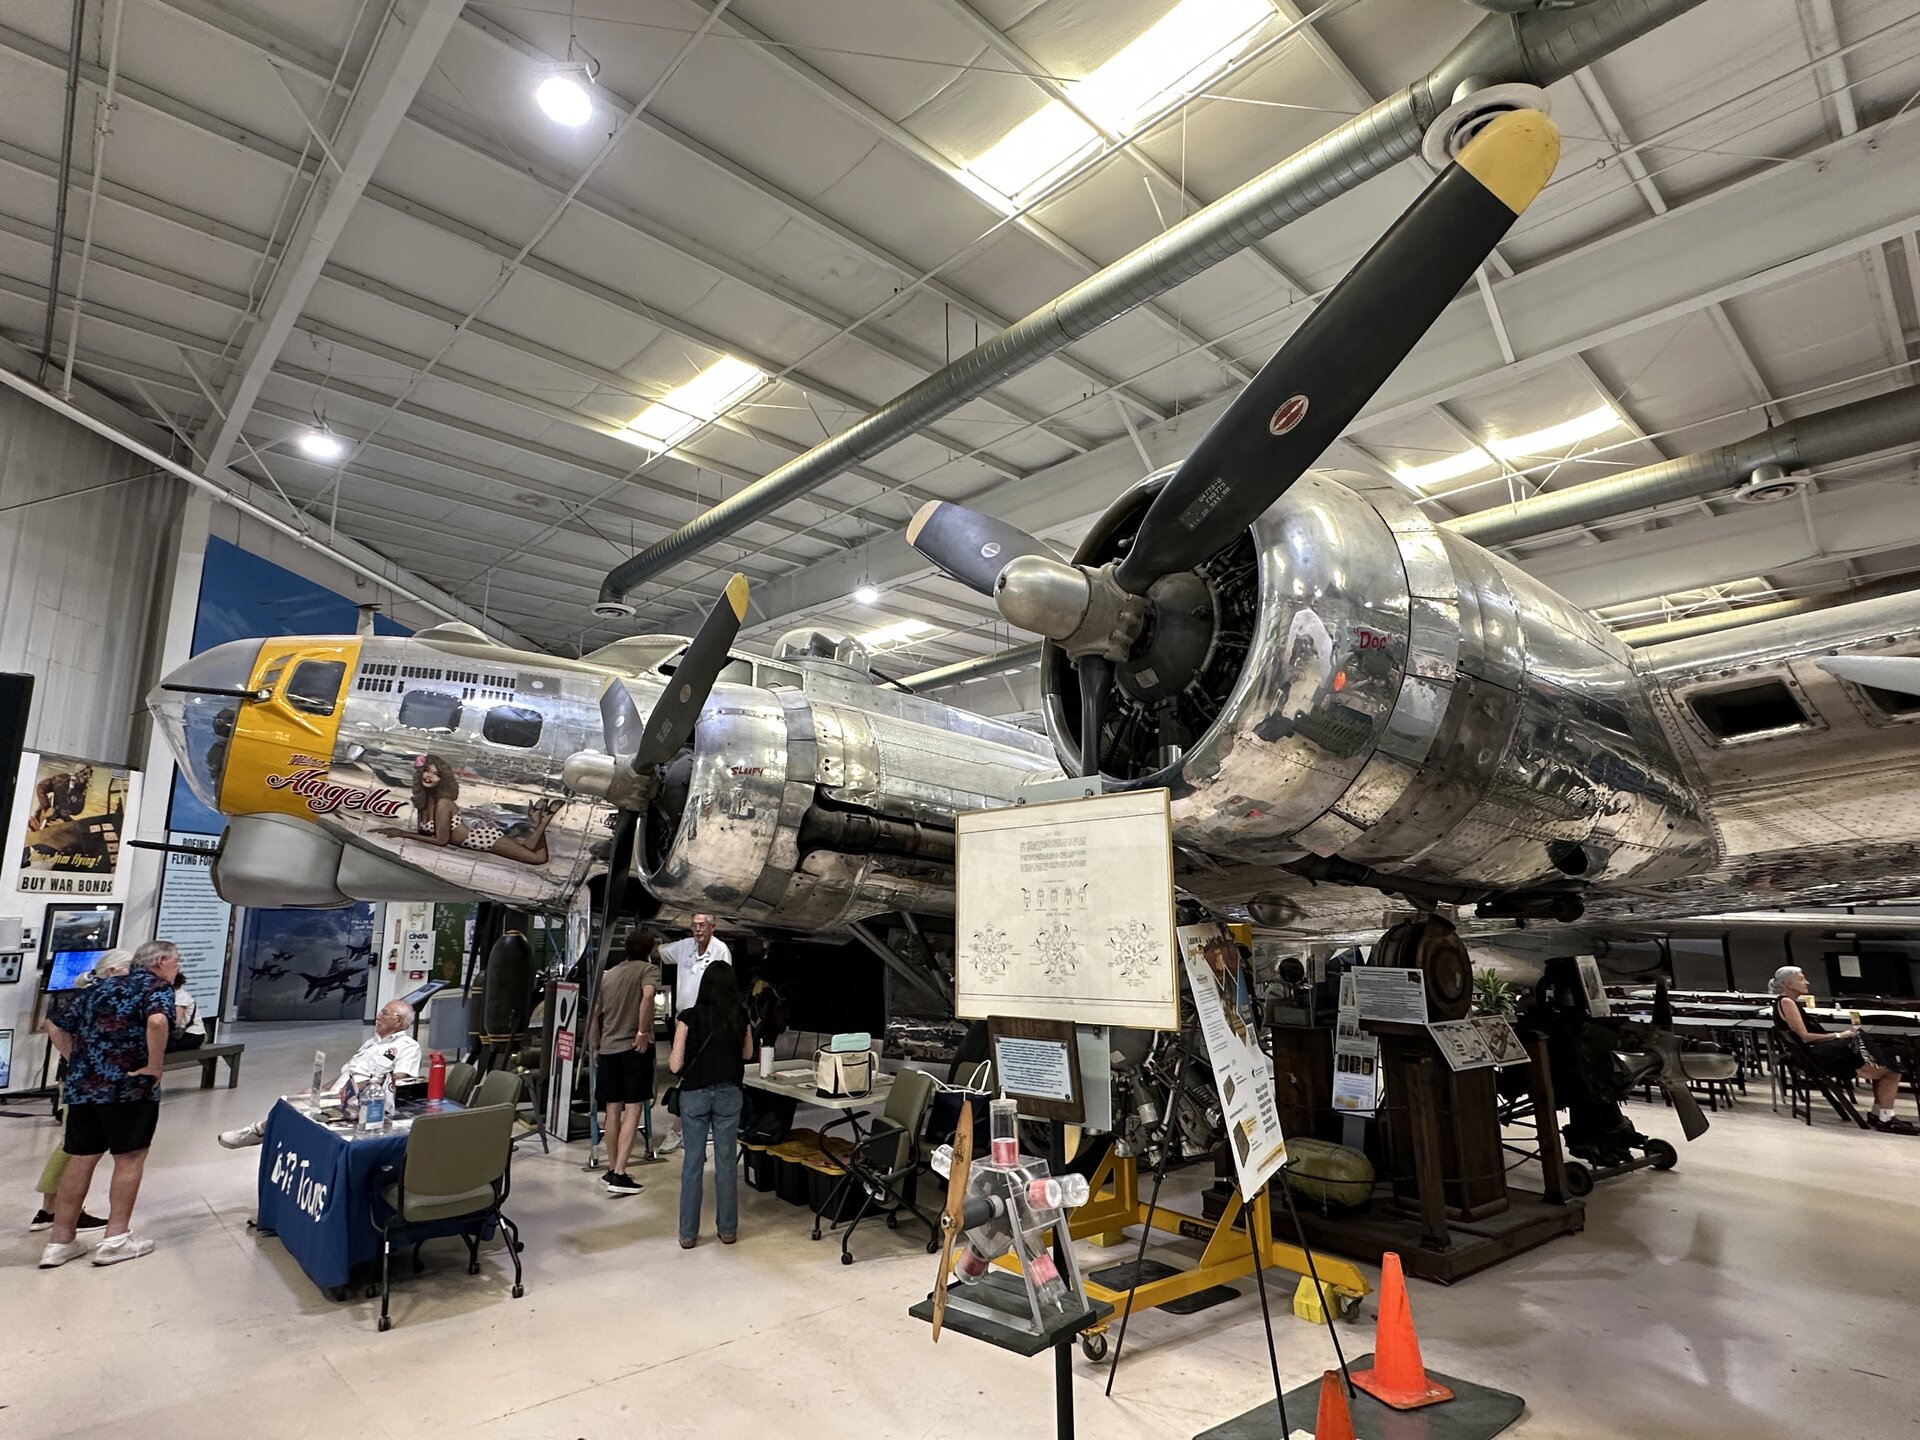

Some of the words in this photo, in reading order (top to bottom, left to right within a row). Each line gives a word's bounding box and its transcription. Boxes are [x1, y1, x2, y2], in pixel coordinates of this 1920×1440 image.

[266, 768, 410, 818] Angela
[71, 853, 102, 869] flying!
[171, 853, 198, 866] FLYING
[21, 876, 46, 891] BUY
[50, 877, 73, 892] WAR
[78, 879, 113, 893] BONDS
[296, 1159, 328, 1223] Tours
